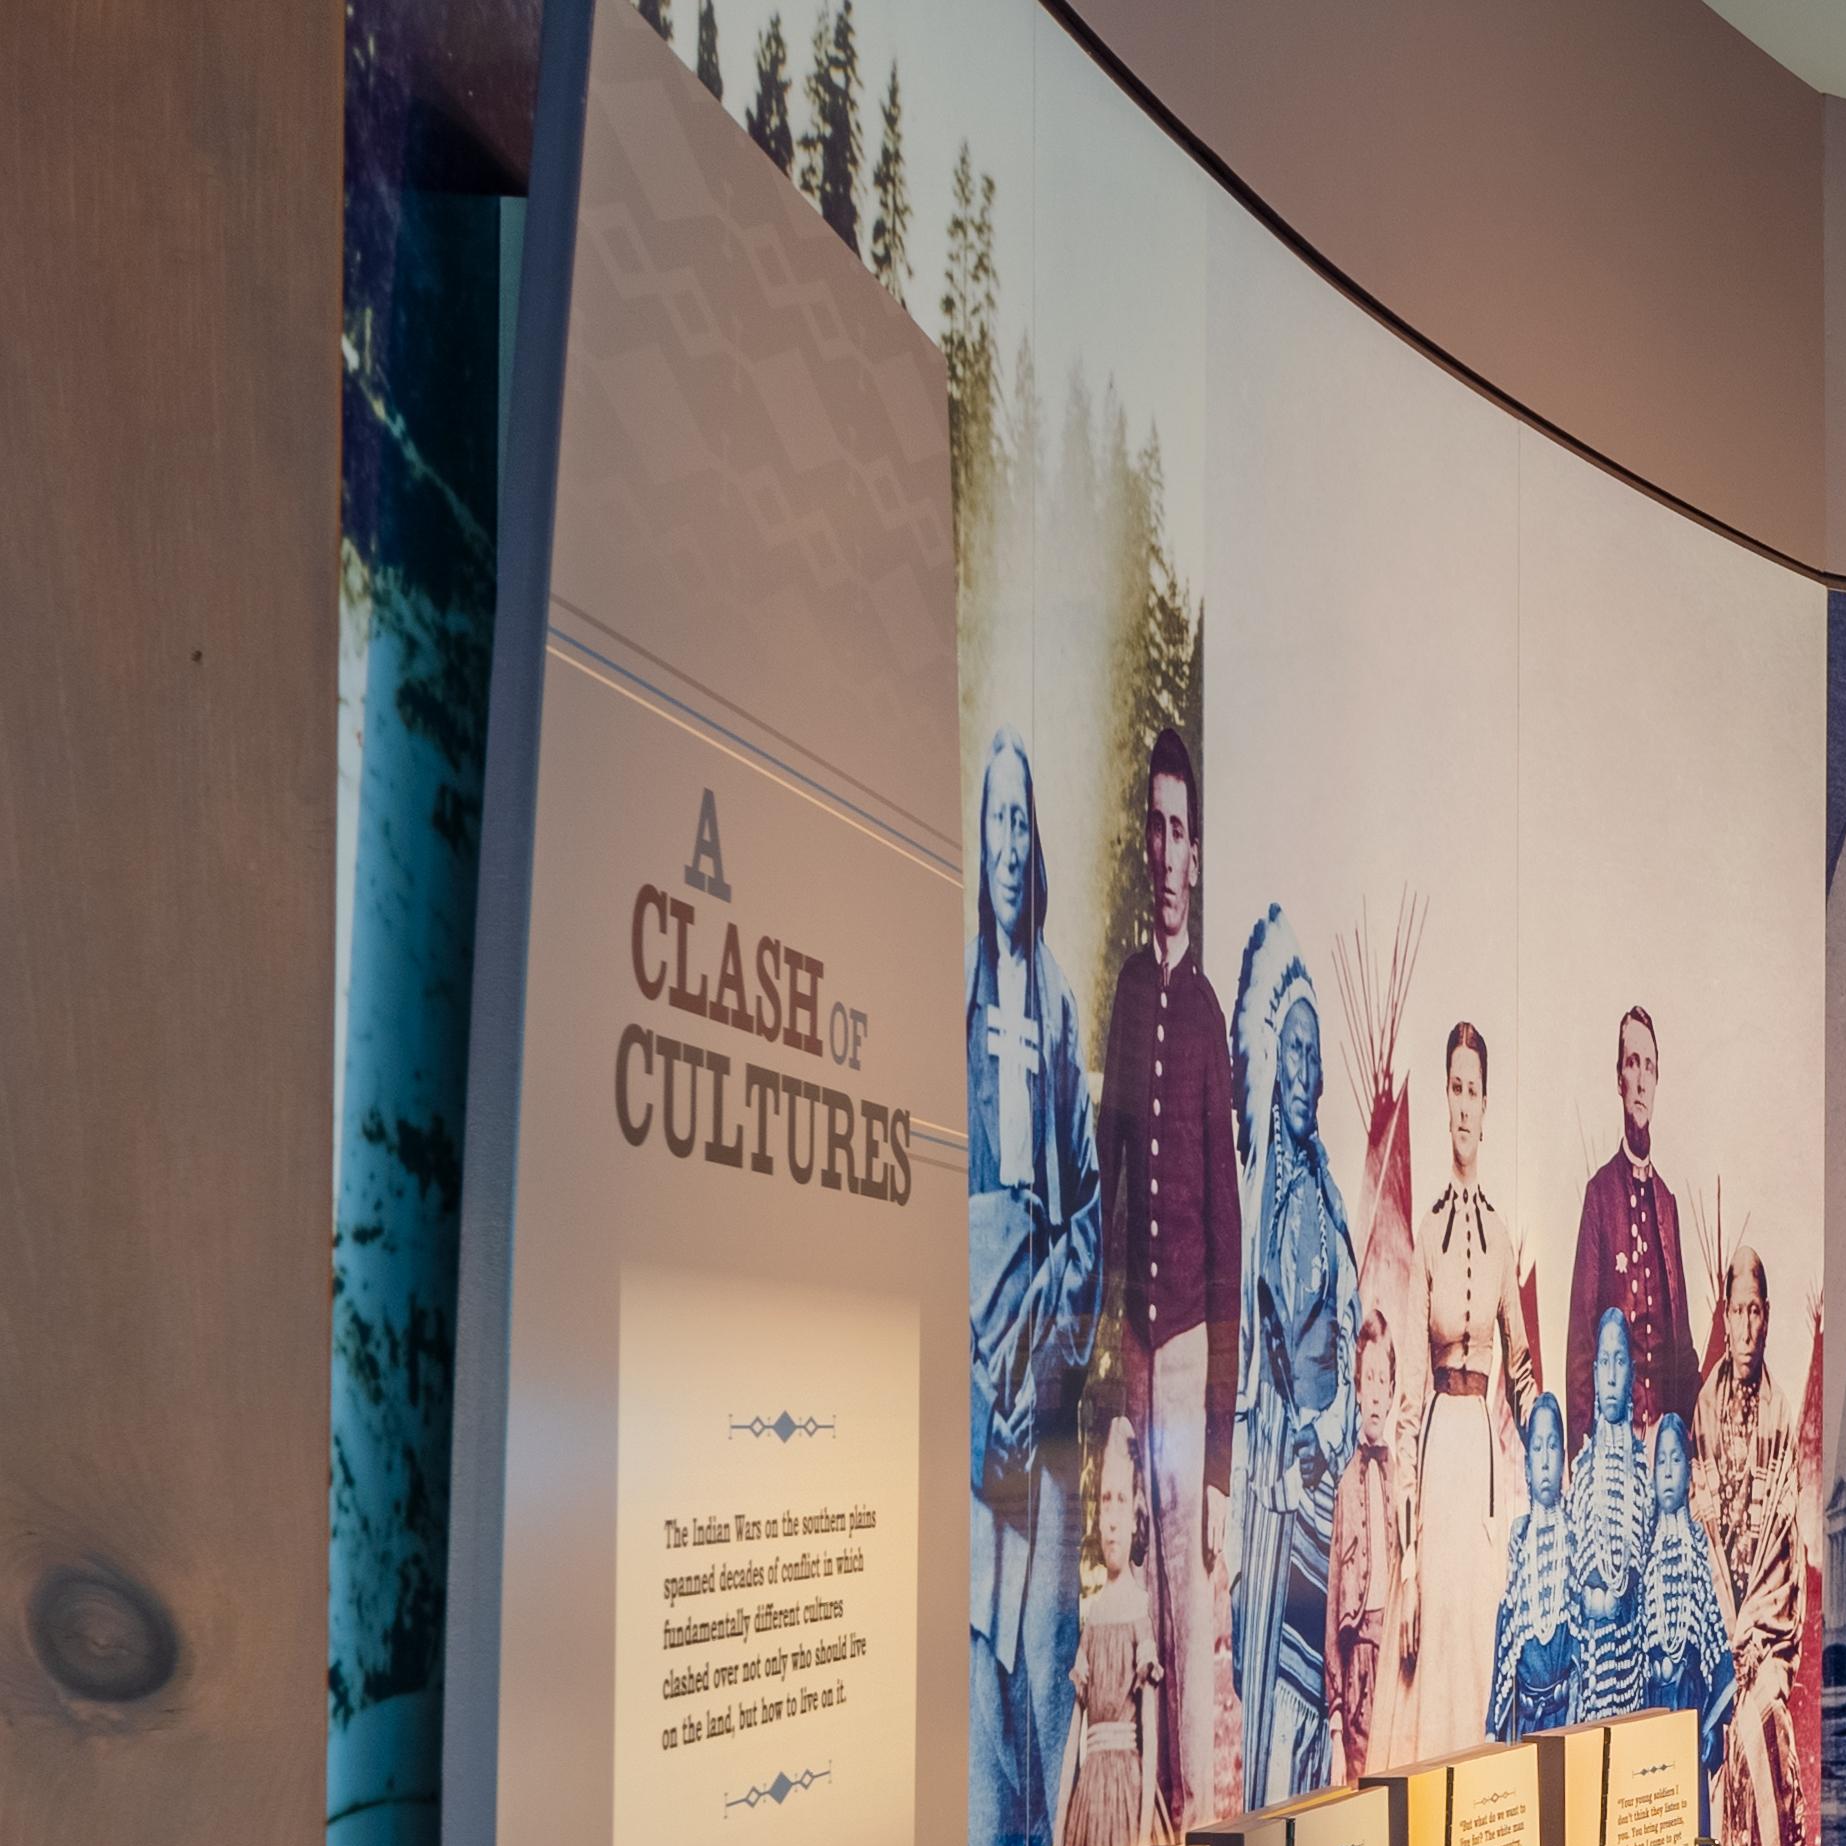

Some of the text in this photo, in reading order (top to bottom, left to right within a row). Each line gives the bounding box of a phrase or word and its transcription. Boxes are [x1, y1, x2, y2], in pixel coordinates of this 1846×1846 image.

[685, 787, 731, 903] A
[631, 883, 868, 1070] CLASH OF
[615, 1024, 911, 1206] CULTURES
[664, 1509, 877, 1550] The Indian Wars on the southern plains
